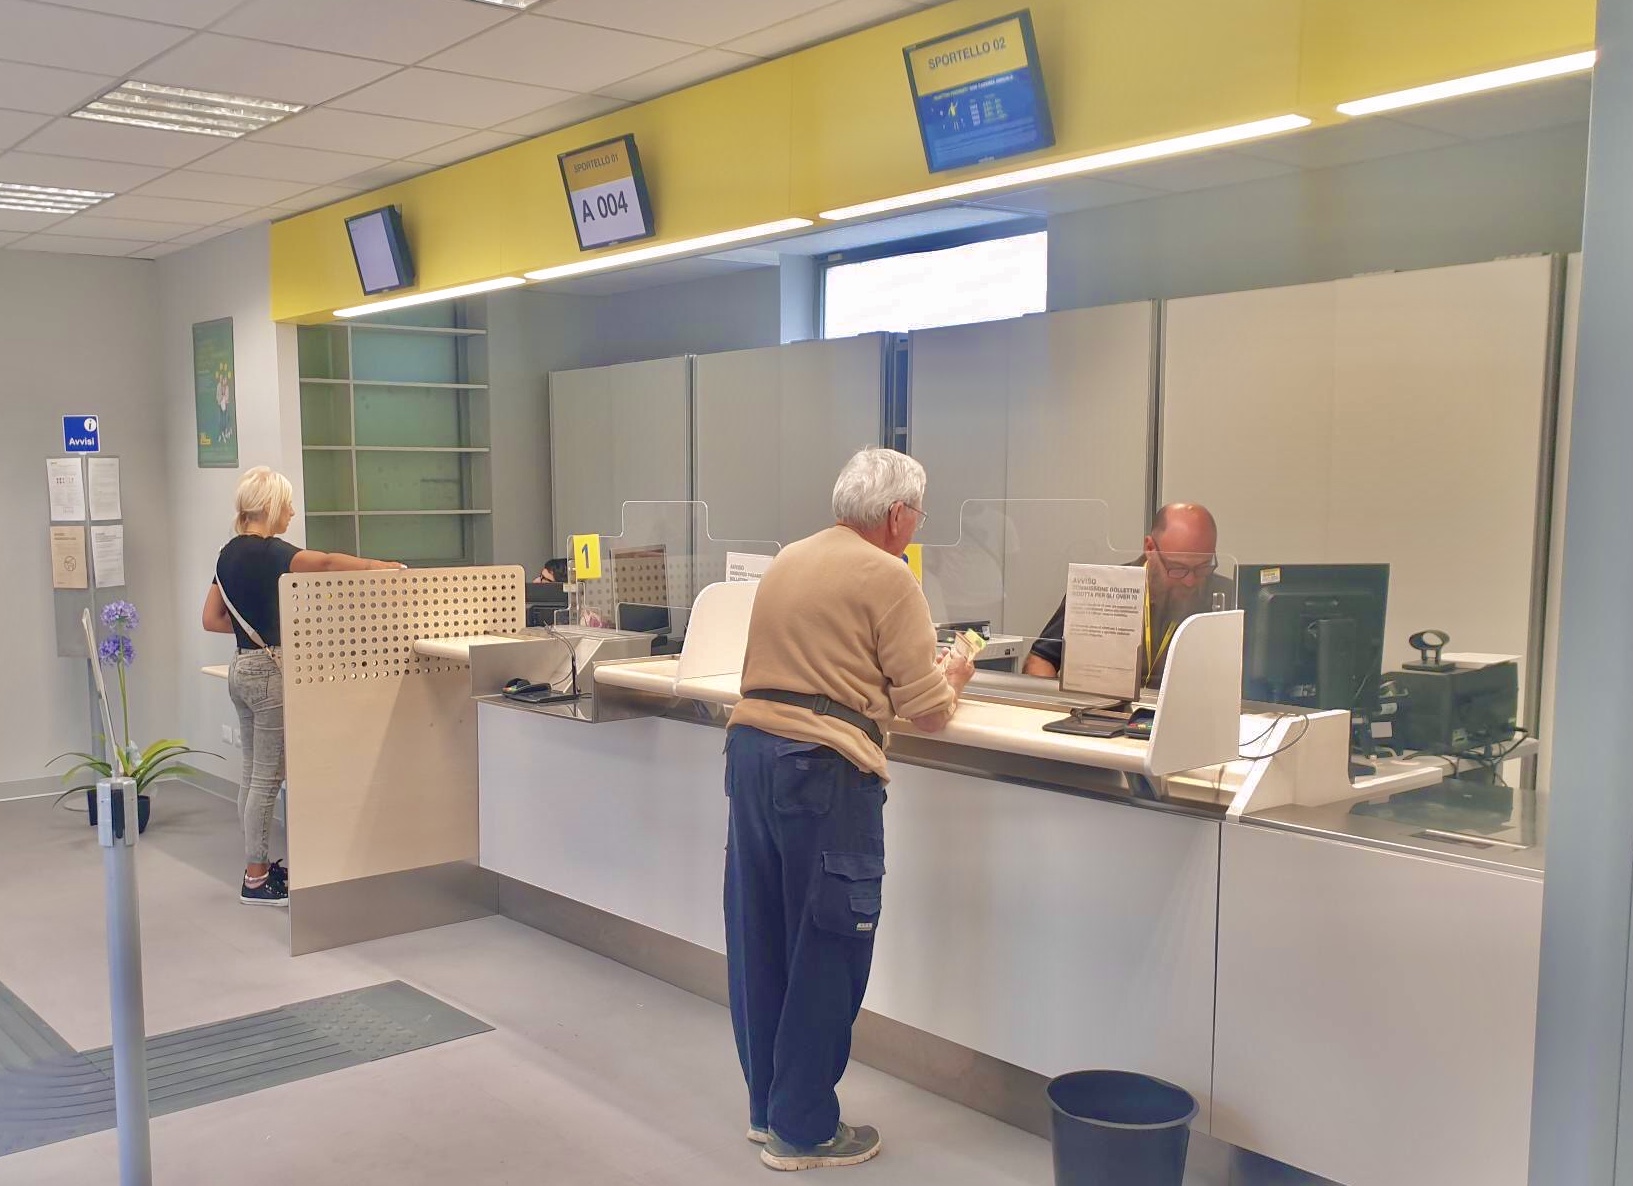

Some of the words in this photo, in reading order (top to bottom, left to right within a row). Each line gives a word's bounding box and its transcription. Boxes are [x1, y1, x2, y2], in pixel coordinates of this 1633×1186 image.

[928, 42, 990, 69] SPORTELLO
[993, 36, 1007, 51] 02
[574, 155, 611, 173] SPORTELLO
[611, 153, 619, 163] 01
[582, 199, 595, 223] A
[596, 190, 629, 219] 004
[69, 436, 95, 446] Avvisi
[581, 543, 589, 569] 1
[1072, 577, 1097, 585] AVVISO
